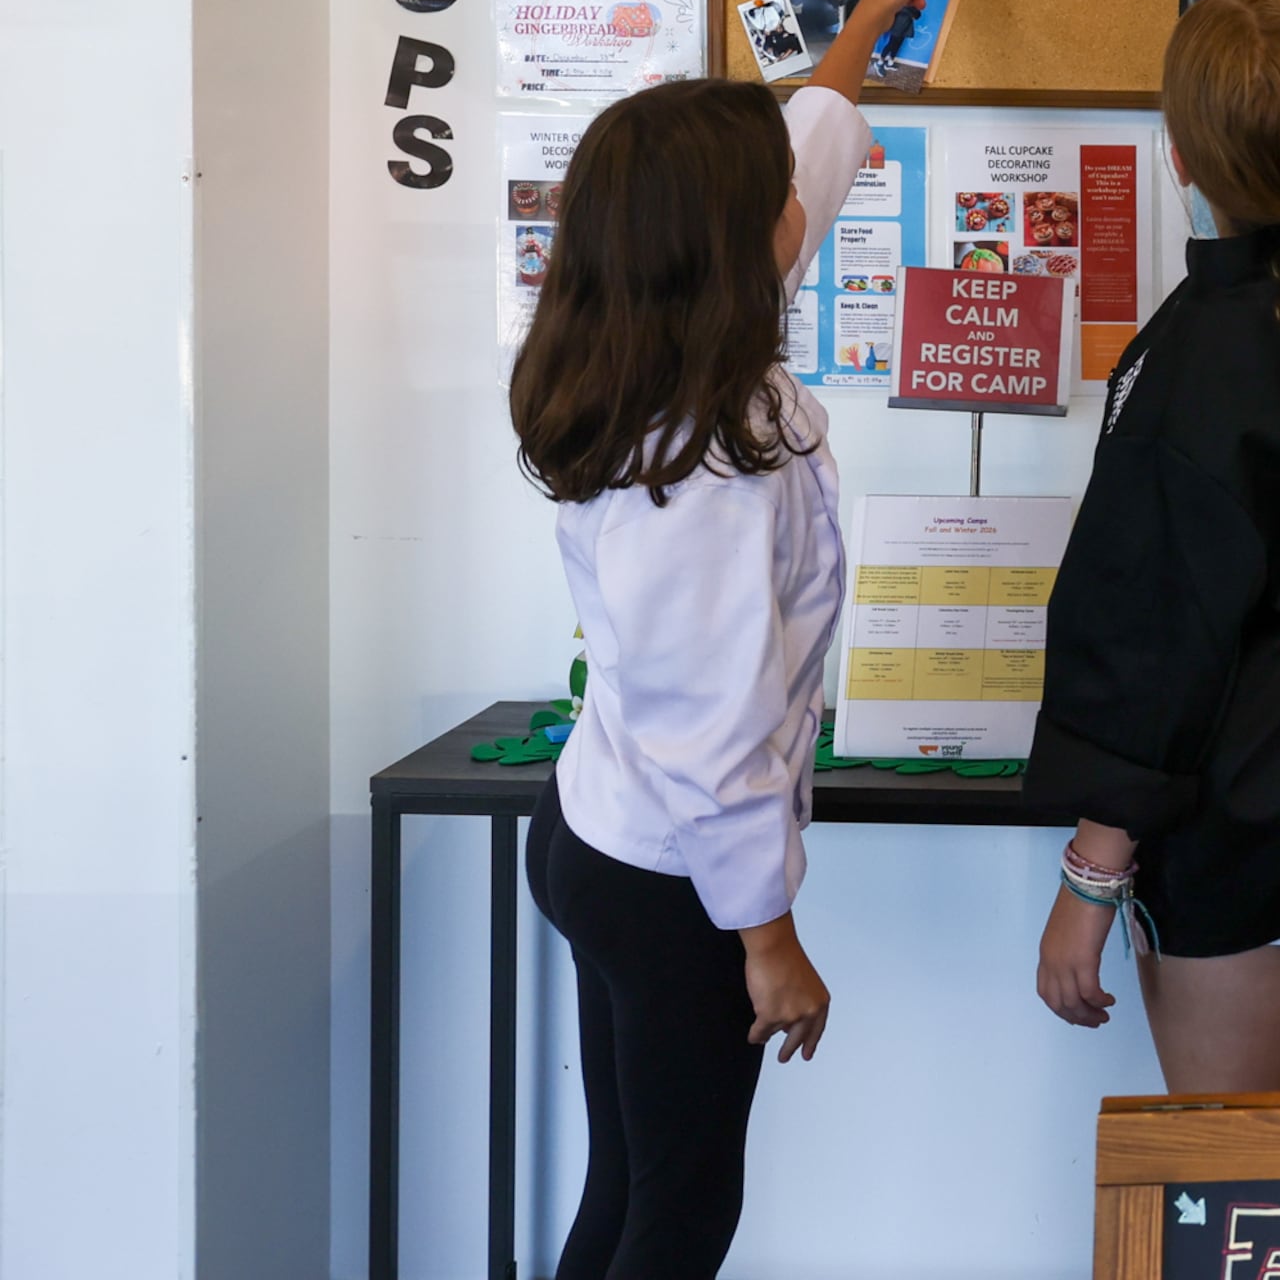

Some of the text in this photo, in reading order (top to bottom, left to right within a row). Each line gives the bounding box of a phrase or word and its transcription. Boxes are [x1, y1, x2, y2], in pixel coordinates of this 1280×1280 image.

[516, 5, 602, 20] HOLIDAY
[514, 23, 617, 36] GINGERBREAD
[562, 33, 632, 52] Workshop
[530, 132, 570, 142] WINTER
[984, 146, 1054, 156] FALL CUPCAKE
[988, 160, 1050, 170] DECORATING
[992, 174, 1048, 183] WORKSHOP
[952, 278, 1018, 301] KEEP
[945, 304, 1019, 328] CALM
[967, 330, 995, 342] AND
[920, 342, 1041, 368] REGISTER
[911, 370, 1048, 396] FOR CAMP
